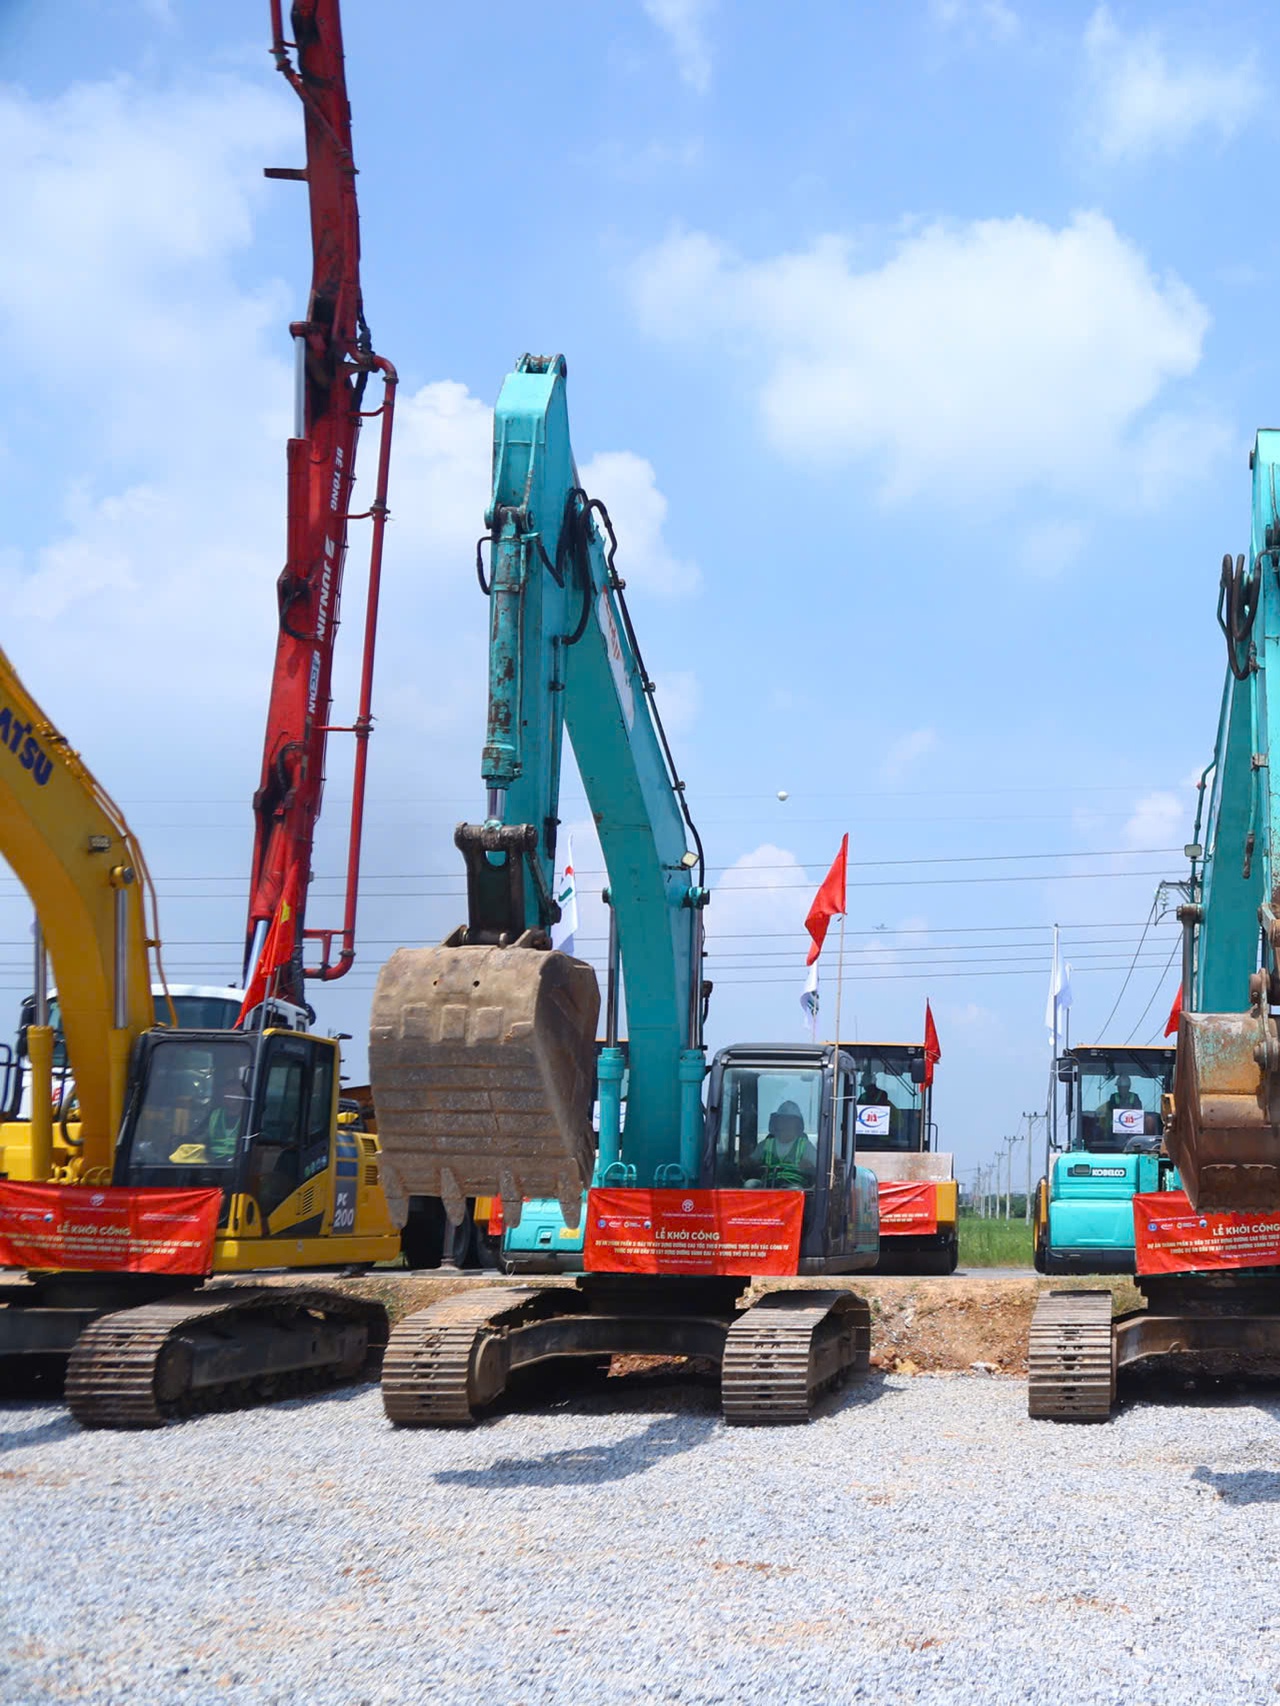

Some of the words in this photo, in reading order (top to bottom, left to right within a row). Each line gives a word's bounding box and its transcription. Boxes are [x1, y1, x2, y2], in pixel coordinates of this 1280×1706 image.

[330, 469, 342, 511] TÔNG
[316, 564, 332, 641] JUNJIN
[1092, 1168, 1125, 1176] KOBELCO
[333, 1208, 354, 1227] 200
[655, 1227, 666, 1239] LỄ
[691, 1229, 720, 1240] CÔNG
[1213, 1224, 1224, 1236] LỄ
[1226, 1224, 1250, 1235] KHỞI
[1252, 1222, 1280, 1233] CÔNG
